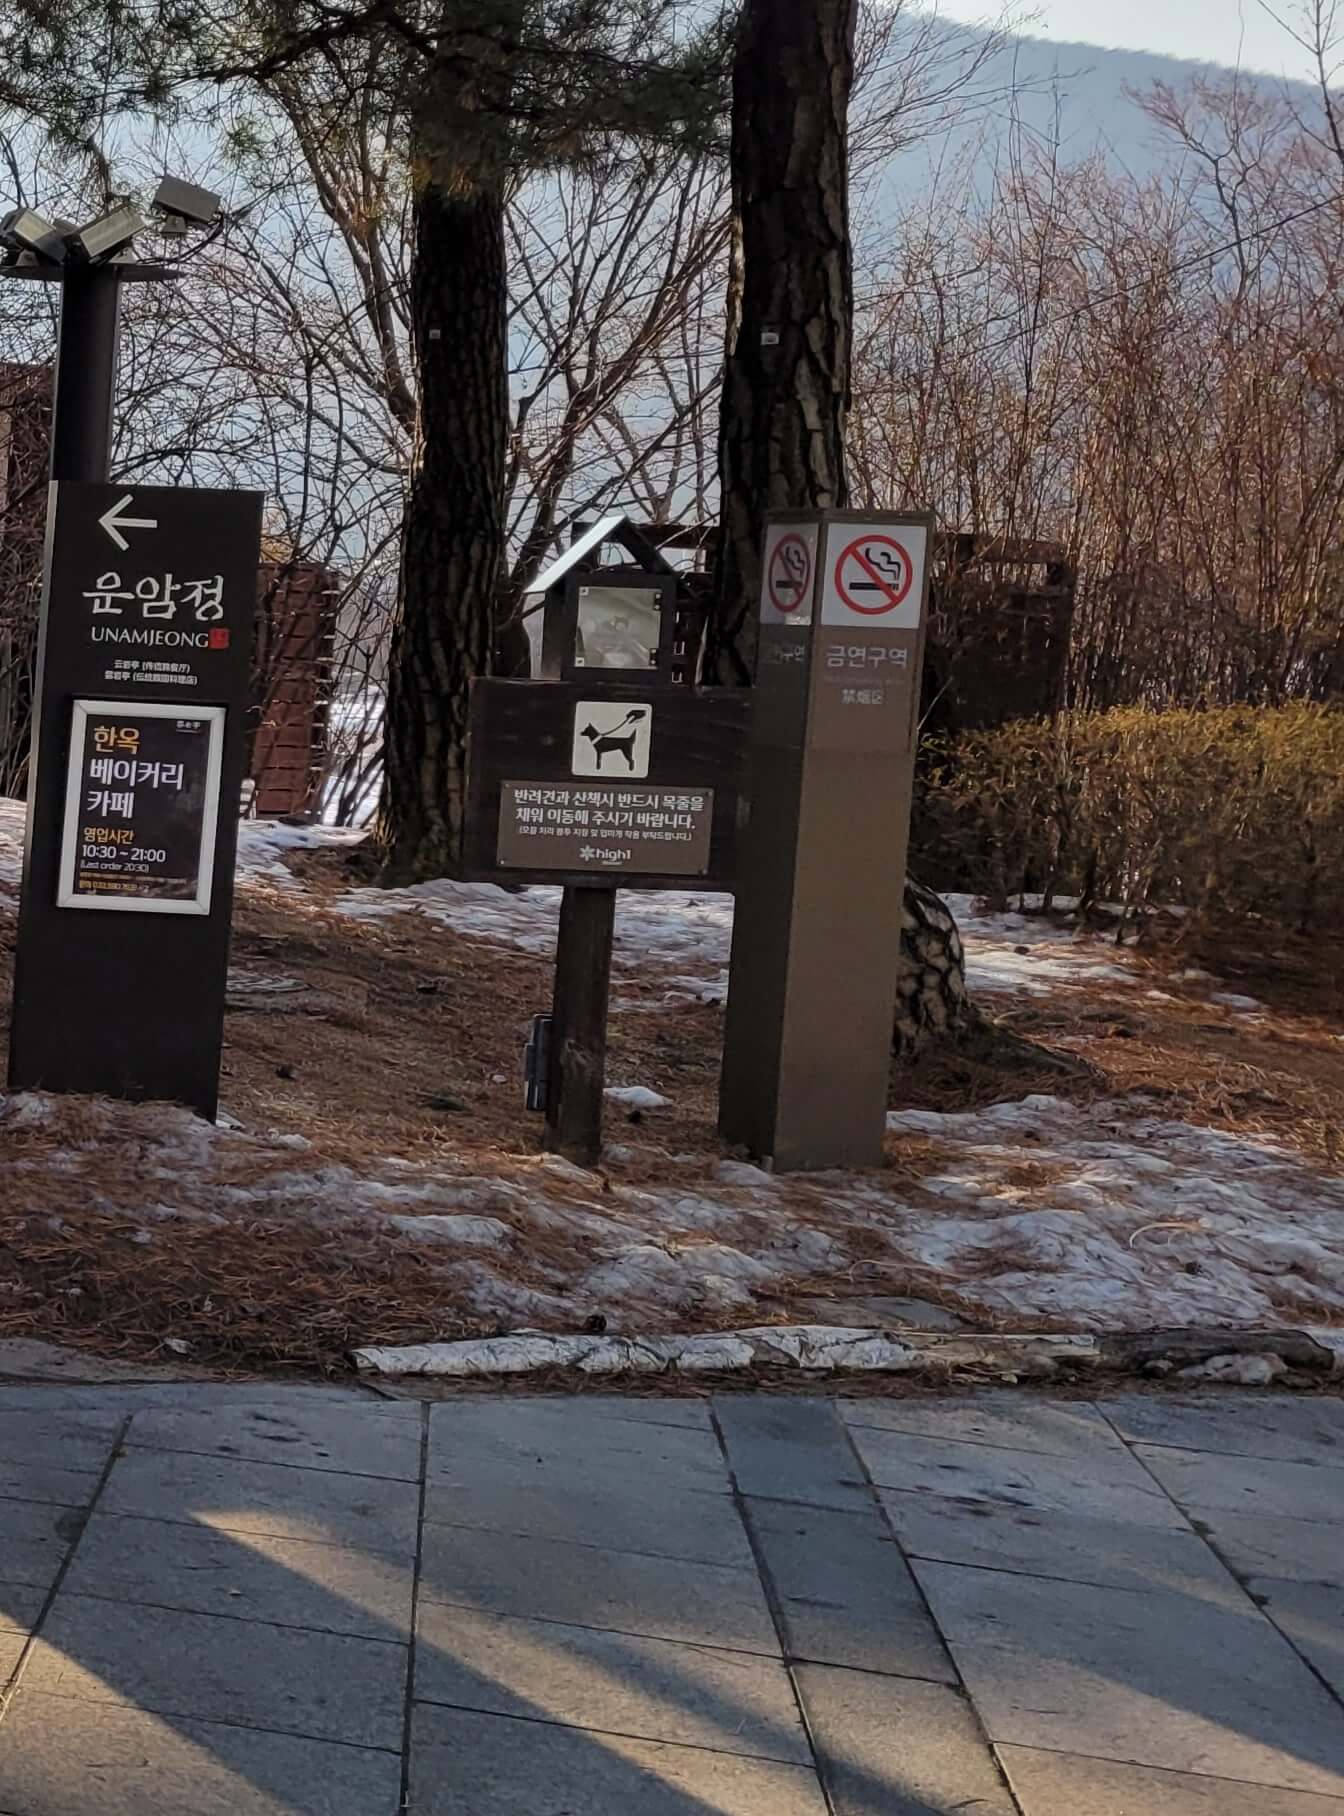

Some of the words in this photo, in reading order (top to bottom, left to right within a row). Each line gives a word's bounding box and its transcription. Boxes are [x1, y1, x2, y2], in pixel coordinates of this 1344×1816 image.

[82, 572, 224, 621] 운암정
[91, 626, 209, 648] UNAMJEONG
[826, 645, 908, 669] 금연구역
[93, 725, 140, 754] 한옥
[89, 758, 184, 790] 베이커리
[86, 790, 135, 819] 카페
[514, 789, 570, 806] 반려견과
[572, 791, 614, 808] 산책시
[618, 793, 659, 810] 반드시
[663, 795, 704, 811] 목줄을
[515, 807, 544, 823] 채워
[591, 811, 633, 827] 주시기
[637, 812, 695, 829] 바랍니다.
[83, 827, 134, 845] 영업시간
[82, 844, 117, 859] 10:30
[130, 847, 166, 862] 21:00
